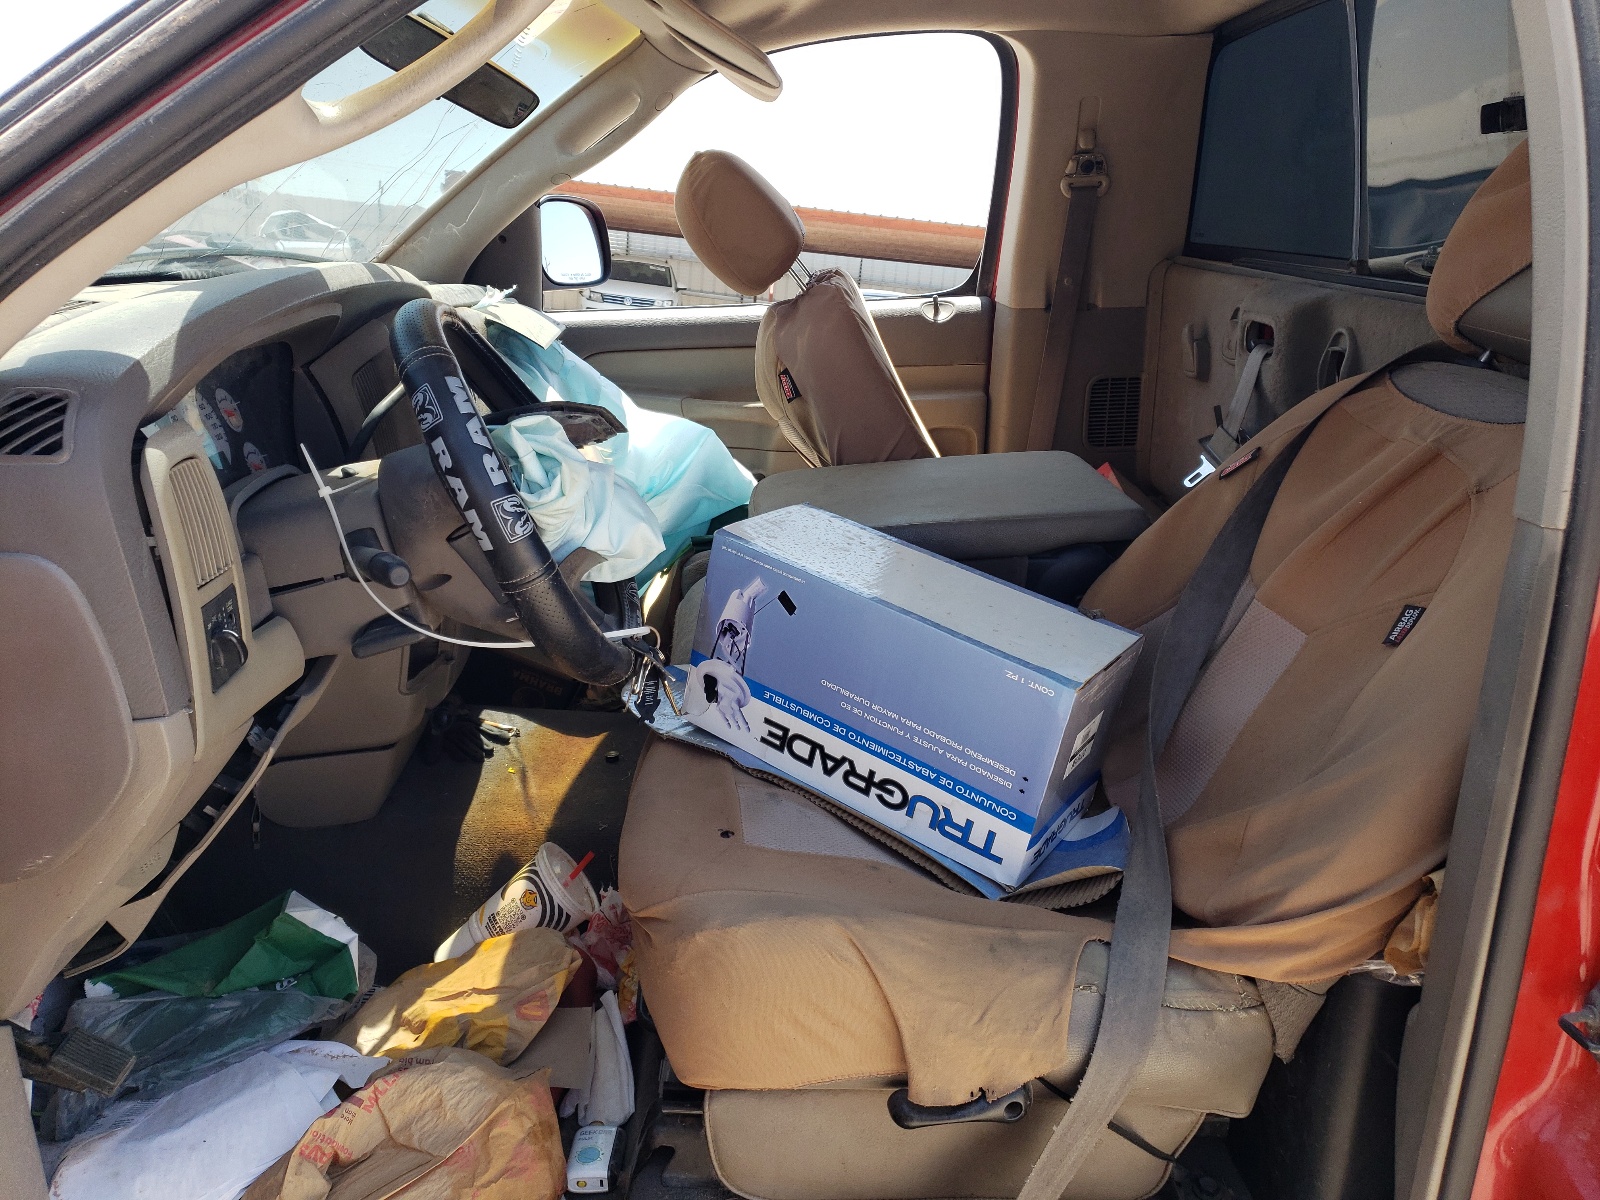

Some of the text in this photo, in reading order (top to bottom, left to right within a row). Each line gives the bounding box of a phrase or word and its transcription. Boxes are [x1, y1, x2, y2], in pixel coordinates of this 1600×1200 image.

[444, 375, 508, 487] RAM
[430, 436, 494, 552] RAM
[1389, 609, 1414, 641] AIRBAG
[1028, 680, 1055, 697] CONT.
[852, 706, 863, 716] DE
[864, 712, 904, 736] FUNCTION
[820, 679, 1017, 777] DESEMPEÑO PROBADO PARA MAYOR DURABILIDAD
[904, 732, 911, 740] Y
[763, 690, 1018, 821] CONJUNTO DE ABASTECIMIENTO DE COMBUSTIBLE
[912, 735, 945, 755] AJUSTE
[945, 751, 968, 767] PARA
[969, 763, 1013, 790] DISEÑADO
[759, 716, 1004, 865] TRUGRADE
